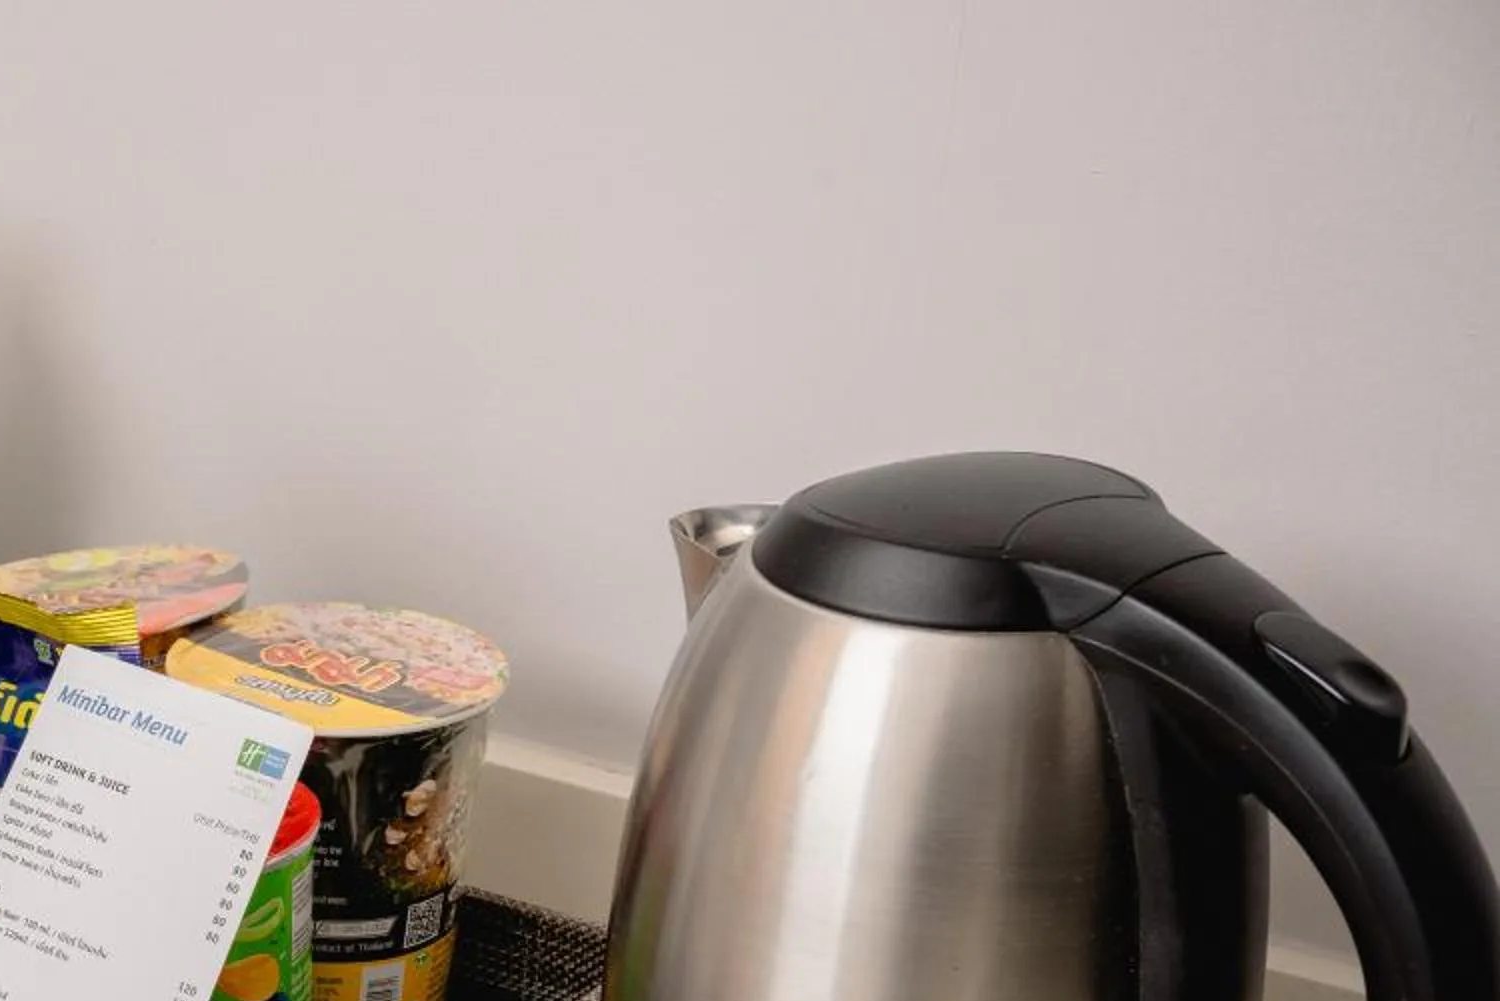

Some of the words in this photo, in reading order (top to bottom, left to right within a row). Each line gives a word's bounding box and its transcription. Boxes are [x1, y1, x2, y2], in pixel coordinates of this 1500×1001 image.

[56, 684, 130, 729] Minibar
[131, 709, 189, 746] Menu
[30, 751, 54, 766] SOFT
[54, 760, 87, 779] DRINK
[99, 776, 130, 795] JUICE
